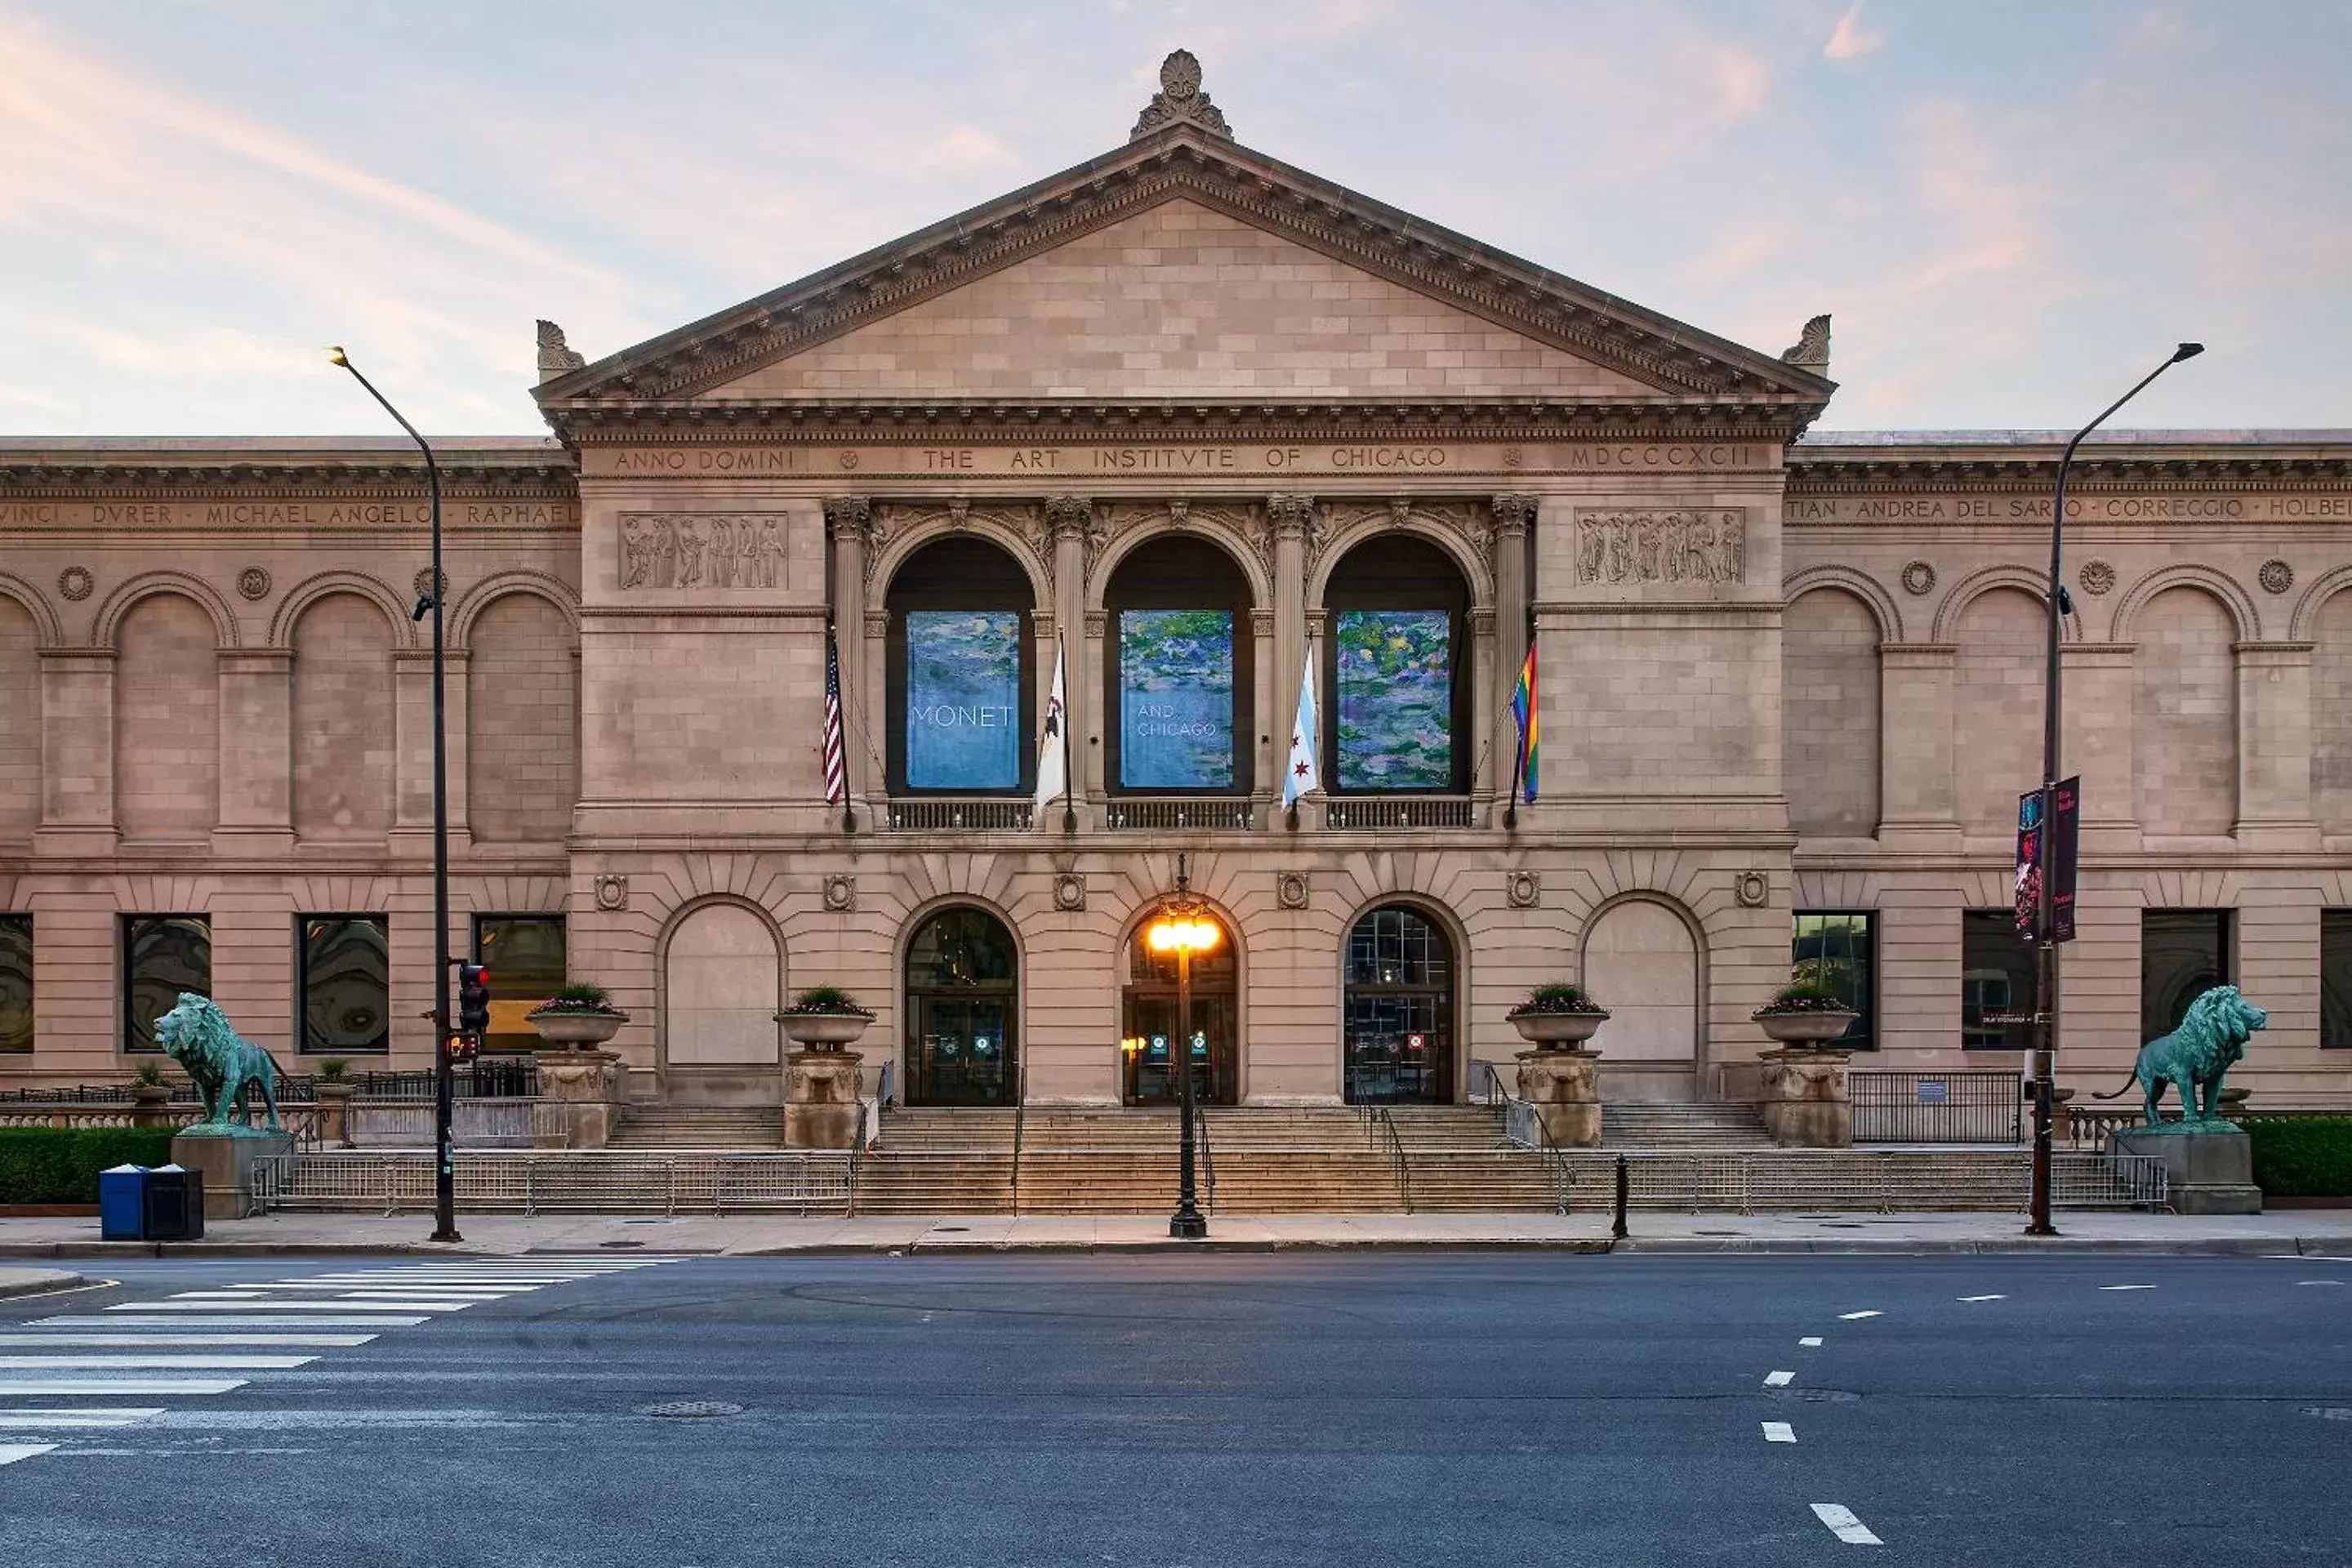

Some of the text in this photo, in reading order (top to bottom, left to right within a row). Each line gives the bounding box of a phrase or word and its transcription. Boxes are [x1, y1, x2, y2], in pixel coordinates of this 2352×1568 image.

[615, 447, 1749, 470] ANNO DOMINI THE ART INSTITVTE OF CHICAGO MDCCCXCII
[92, 506, 172, 523] DVRER
[207, 505, 317, 523] MICHAEL
[327, 505, 432, 523] ANGELO
[467, 505, 581, 523] RAPHAEL
[1786, 498, 2351, 518] TIAN ANDREA DEL SARO CORREGGIO HOLBEI
[911, 705, 1014, 727] MONET
[1138, 704, 1174, 718] AND
[1138, 722, 1216, 736] CHICAGO
